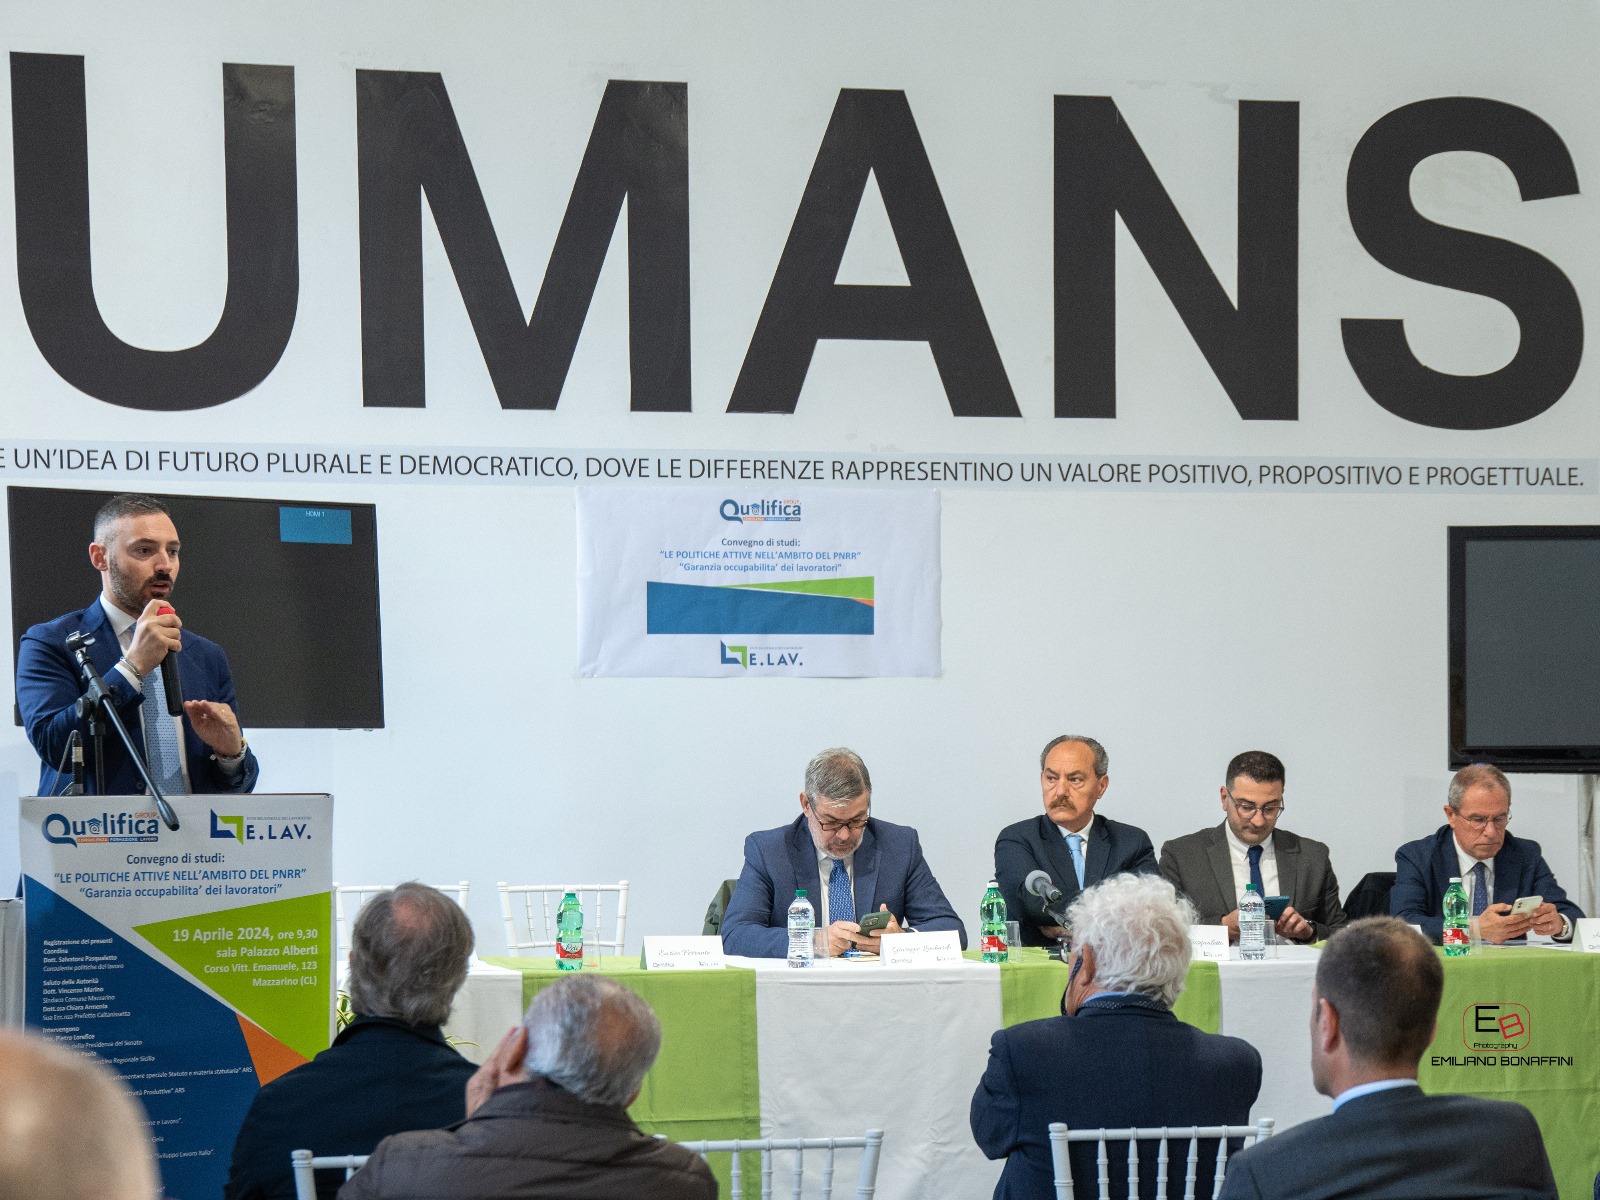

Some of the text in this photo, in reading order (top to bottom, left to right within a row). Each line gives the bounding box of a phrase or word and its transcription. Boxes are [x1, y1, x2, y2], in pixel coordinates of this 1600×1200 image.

[10, 51, 1584, 430] UMANS
[14, 448, 117, 470] UN'IDEA
[125, 450, 150, 471] DI
[158, 451, 259, 473] FUTURO
[266, 452, 371, 474] PLURALE
[380, 454, 392, 474] E
[400, 454, 579, 481] DEMOCRATICO,
[585, 457, 649, 478] DOVE
[657, 458, 682, 479] LE
[689, 458, 824, 480] DIFFERENZE
[831, 460, 1013, 482] RAPPRESENTINO
[1020, 462, 1053, 482] UN
[1057, 463, 1141, 483] VALORE
[1148, 464, 1252, 487] POSITIVO,
[1259, 465, 1402, 486] PROPOSITIVO
[1409, 467, 1419, 485] E
[1427, 466, 1584, 487] PROGETTUALE.
[721, 538, 800, 547] Convegno di studi:
[676, 550, 720, 559] POLITICHE
[722, 551, 752, 559] ATTIVE
[754, 551, 813, 560] NELL'AMBITO
[815, 552, 831, 560] DEL
[723, 563, 778, 572] occupabilita'
[780, 564, 794, 572] dei
[749, 653, 803, 666] E.LAV.
[246, 824, 312, 840] E.LAV.
[126, 852, 225, 866] Convegno di studi:
[75, 872, 130, 883] POLITICHE
[133, 870, 170, 882] ATTIVE
[173, 869, 247, 881] NELL'AMBITO
[250, 869, 269, 880] DEL
[135, 885, 202, 899] occupabilita'
[205, 884, 222, 895] dei
[172, 927, 318, 943] 19 Aprile 2024, ore 9,30
[43, 939, 80, 947] Registrazione
[216, 945, 318, 958] sala Palazzo Alberti
[203, 961, 317, 973] Corso Vitt. Emanuele, 123
[252, 975, 317, 987] Mazzarino (CL)
[146, 1072, 168, 1080] speciale
